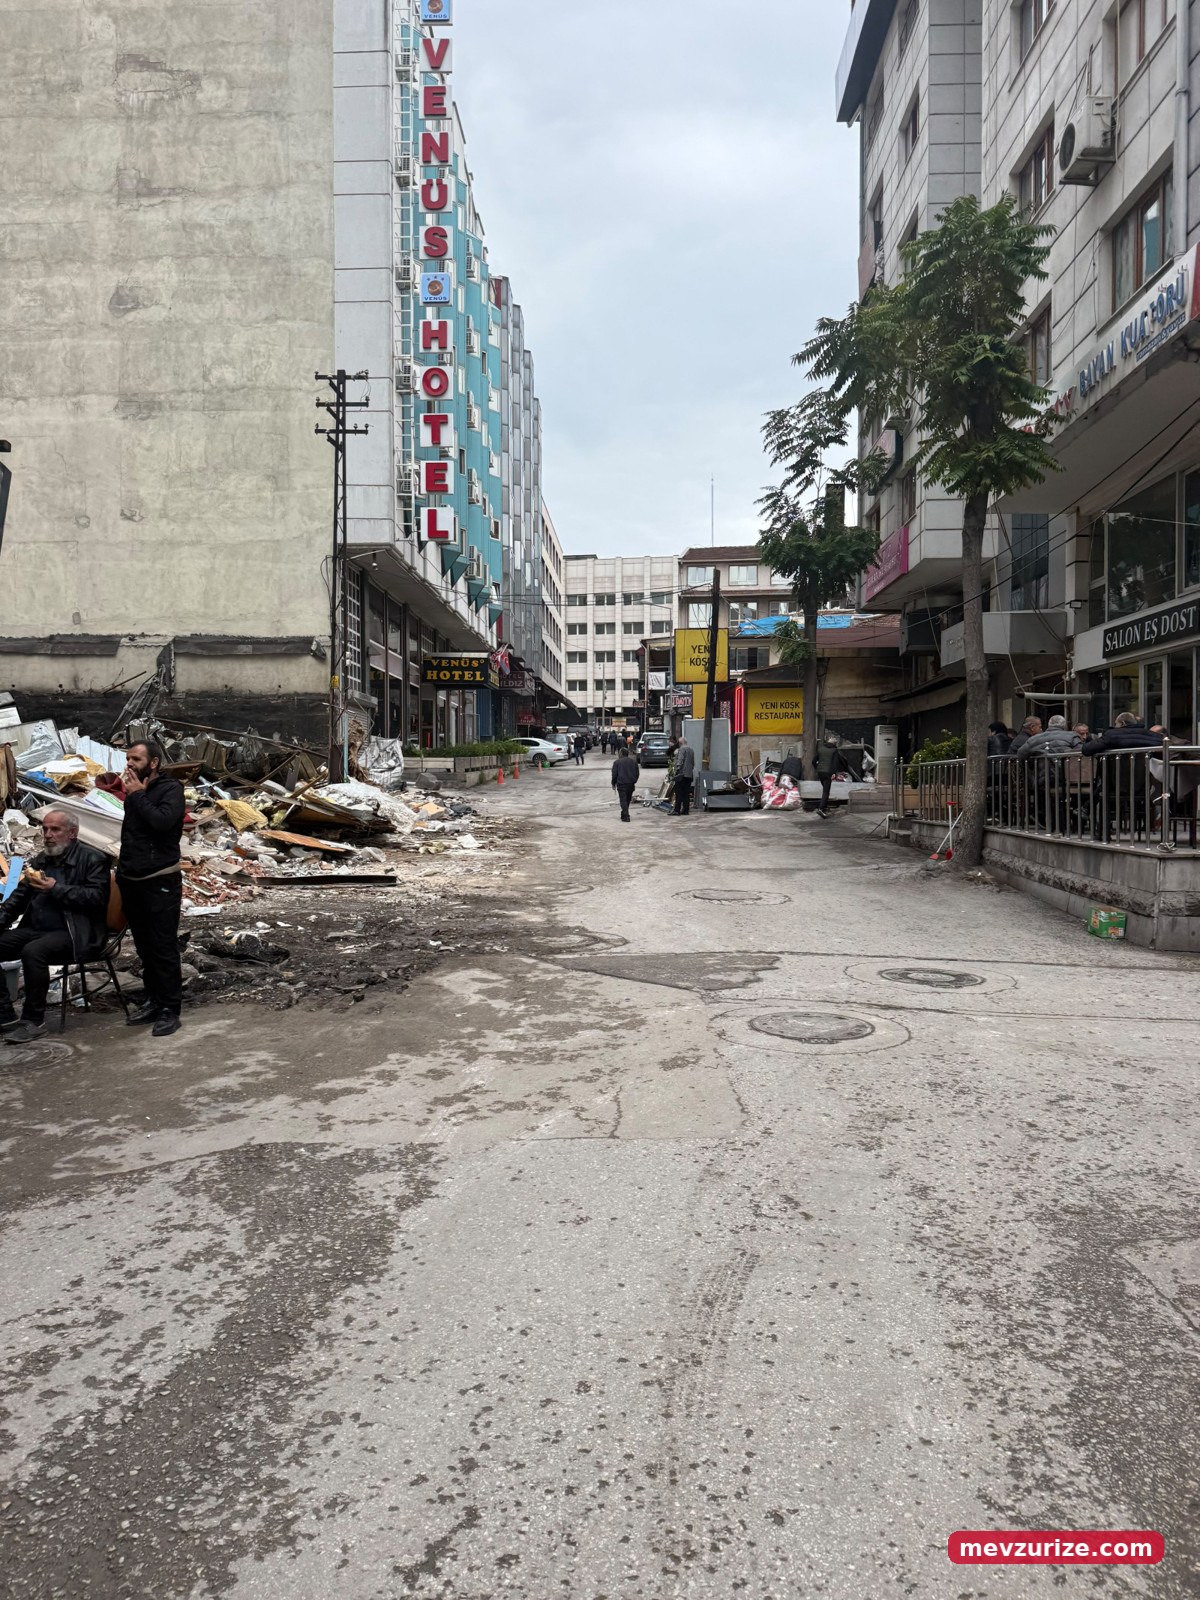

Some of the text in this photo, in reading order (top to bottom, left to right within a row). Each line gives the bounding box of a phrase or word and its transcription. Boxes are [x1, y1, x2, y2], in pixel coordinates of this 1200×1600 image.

[422, 38, 450, 257] VENÜS
[1079, 341, 1117, 398] BAYAN
[422, 320, 450, 538] HOTEL
[1105, 605, 1197, 652] SALON EŞ DOST
[431, 658, 479, 667] VENÜS
[691, 645, 710, 654] YEN
[426, 670, 485, 681] HOTEL
[780, 700, 801, 711] KÖŞK
